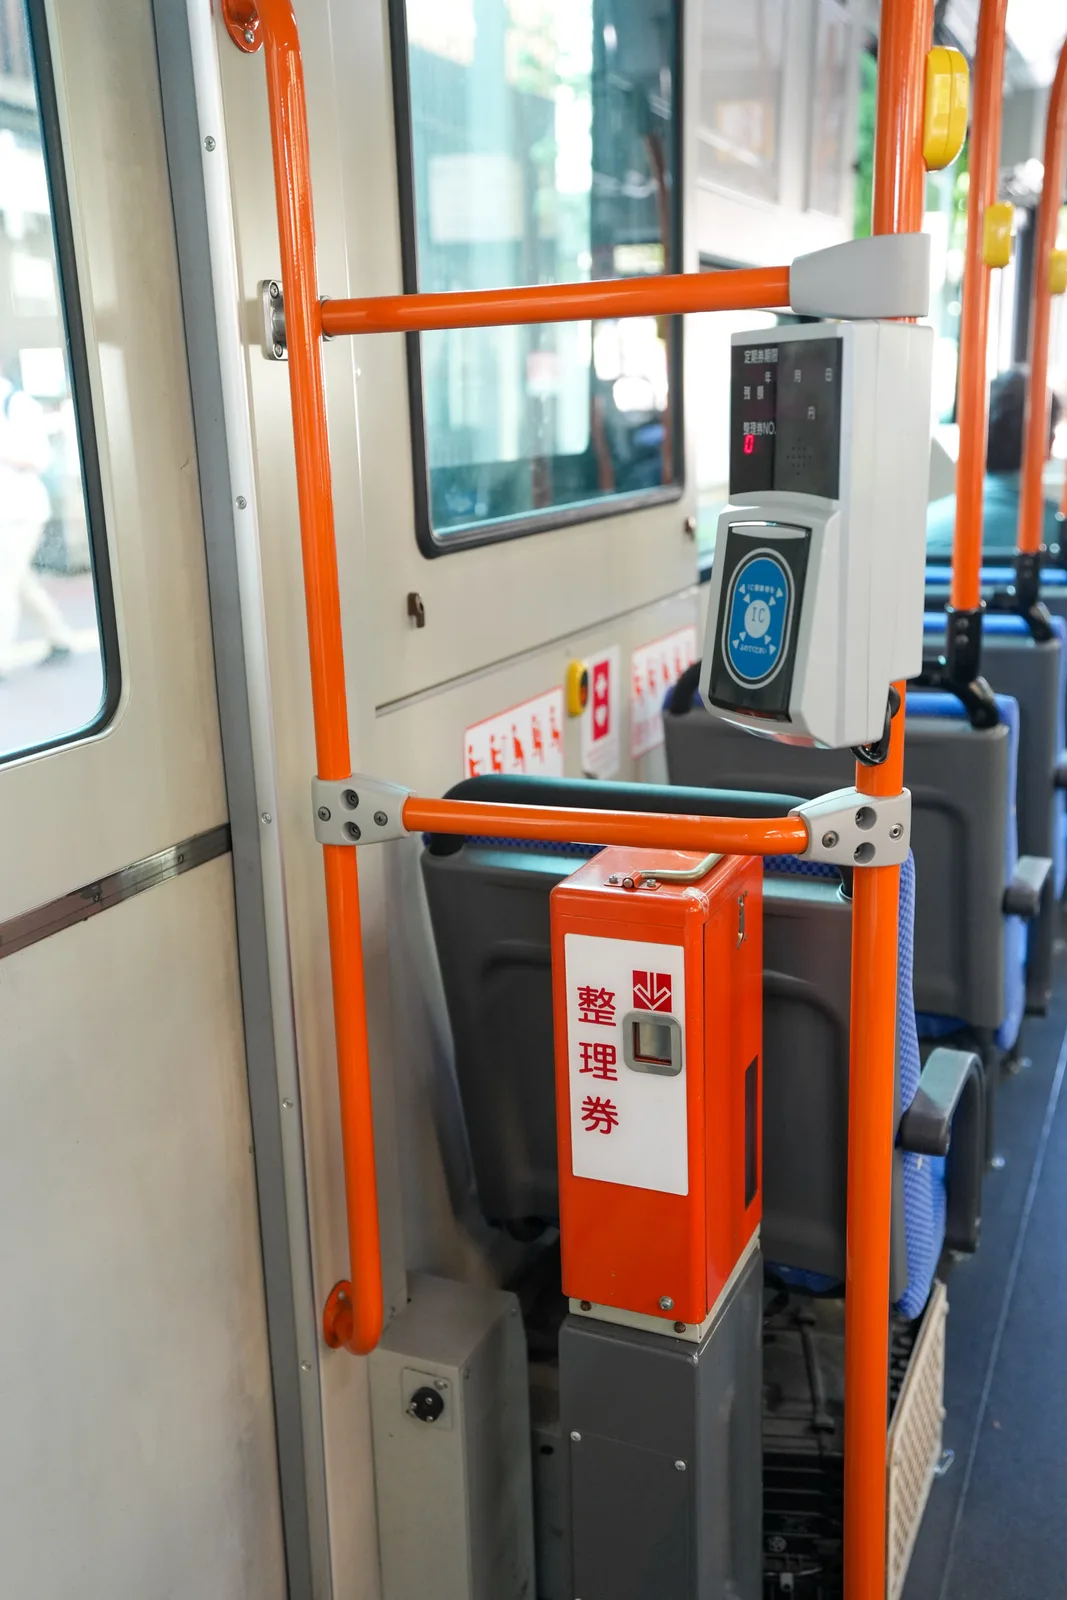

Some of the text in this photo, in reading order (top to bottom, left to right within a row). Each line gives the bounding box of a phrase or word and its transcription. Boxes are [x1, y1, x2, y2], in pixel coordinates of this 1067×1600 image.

[794, 369, 801, 382] 月
[825, 367, 832, 381] 日
[743, 434, 754, 454] 0
[751, 606, 765, 623] IC
[577, 985, 619, 1135] 整理券
